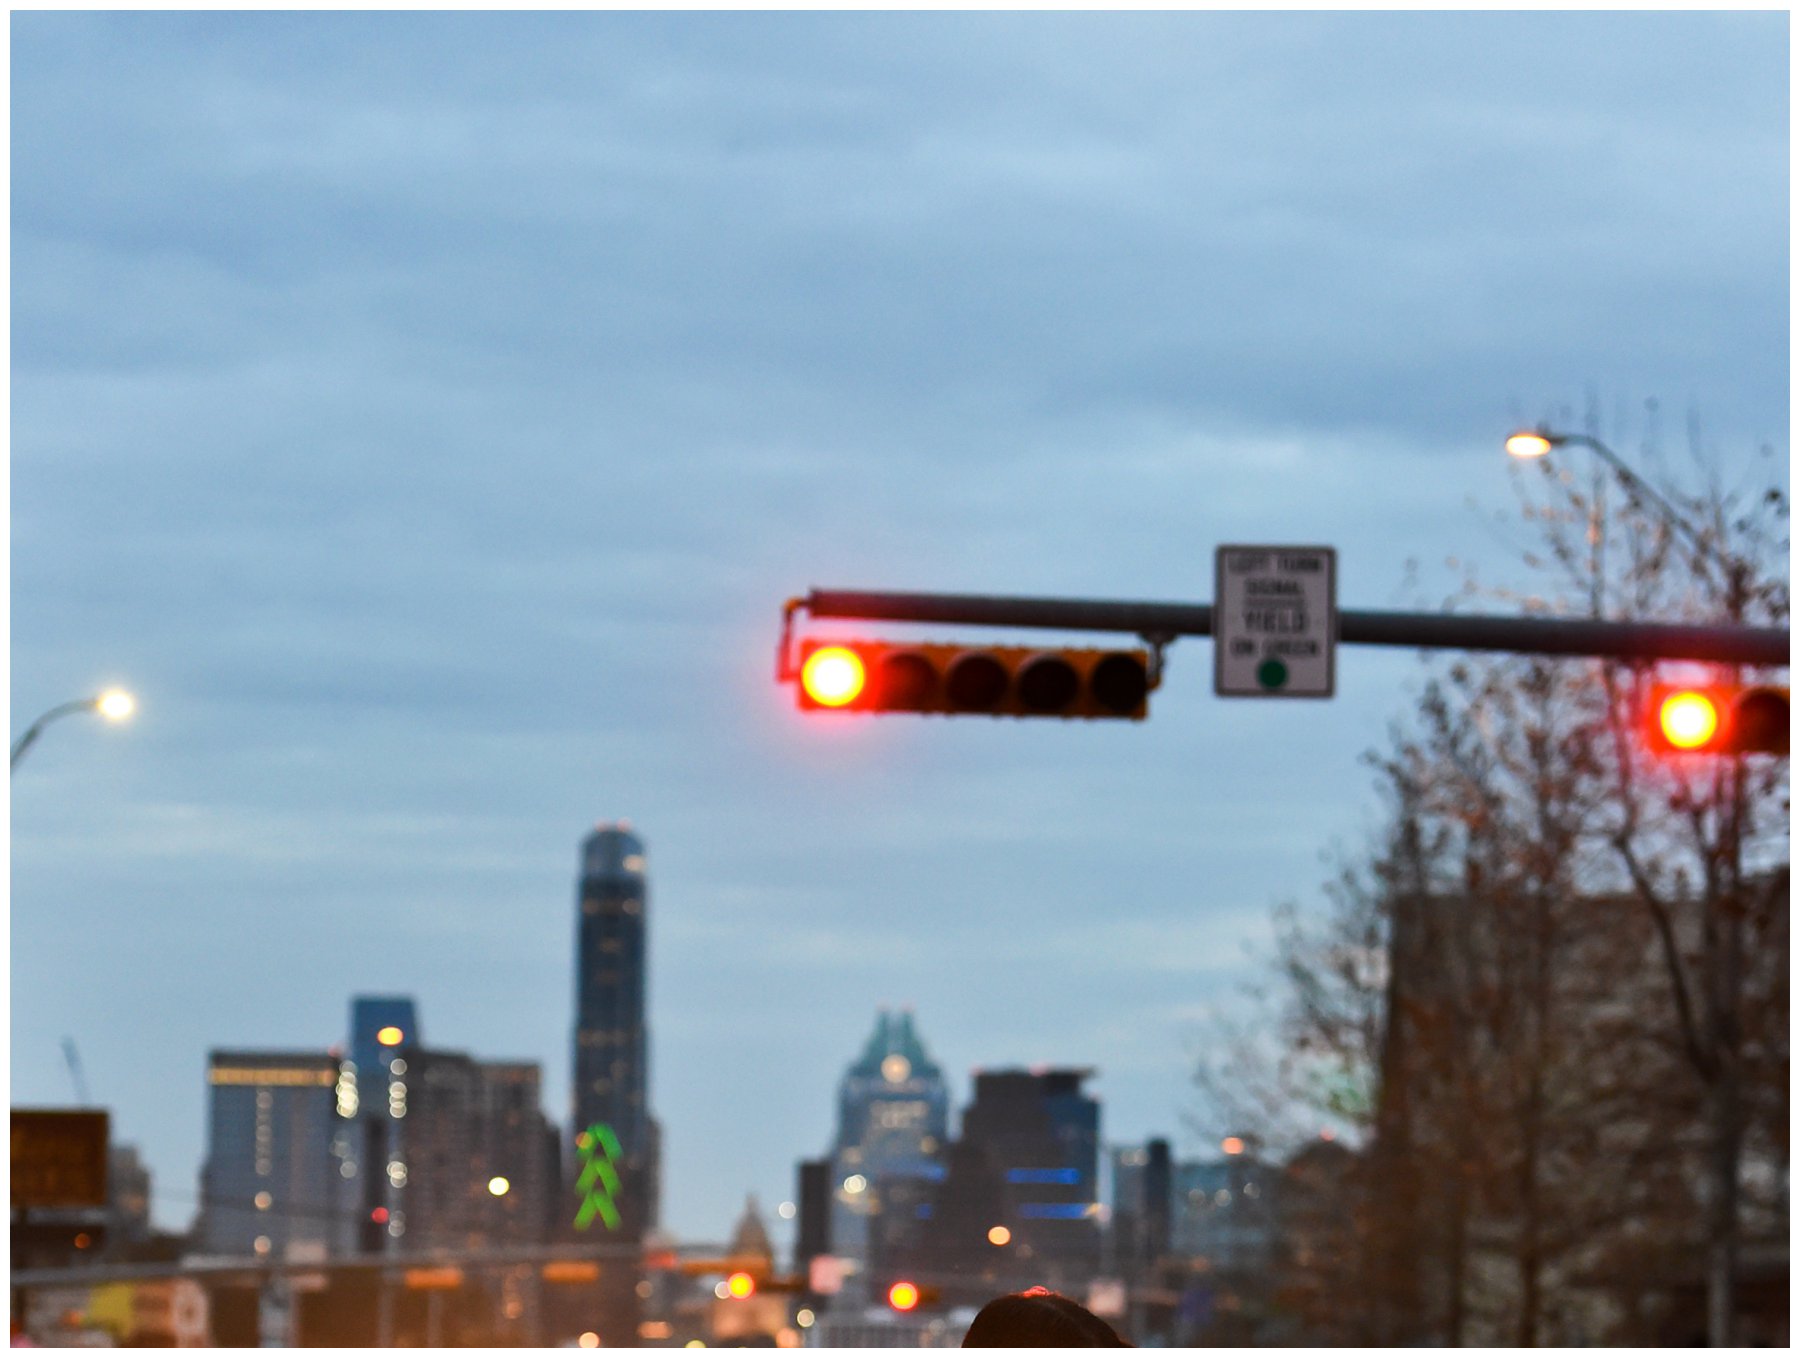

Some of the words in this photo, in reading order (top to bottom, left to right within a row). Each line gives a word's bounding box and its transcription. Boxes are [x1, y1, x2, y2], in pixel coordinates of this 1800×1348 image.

[1279, 555, 1321, 572] TURN
[1246, 578, 1304, 595] SIGNAL
[1244, 606, 1308, 631] YIELD
[1231, 637, 1256, 656] ON
[1262, 638, 1318, 656] GREEN
